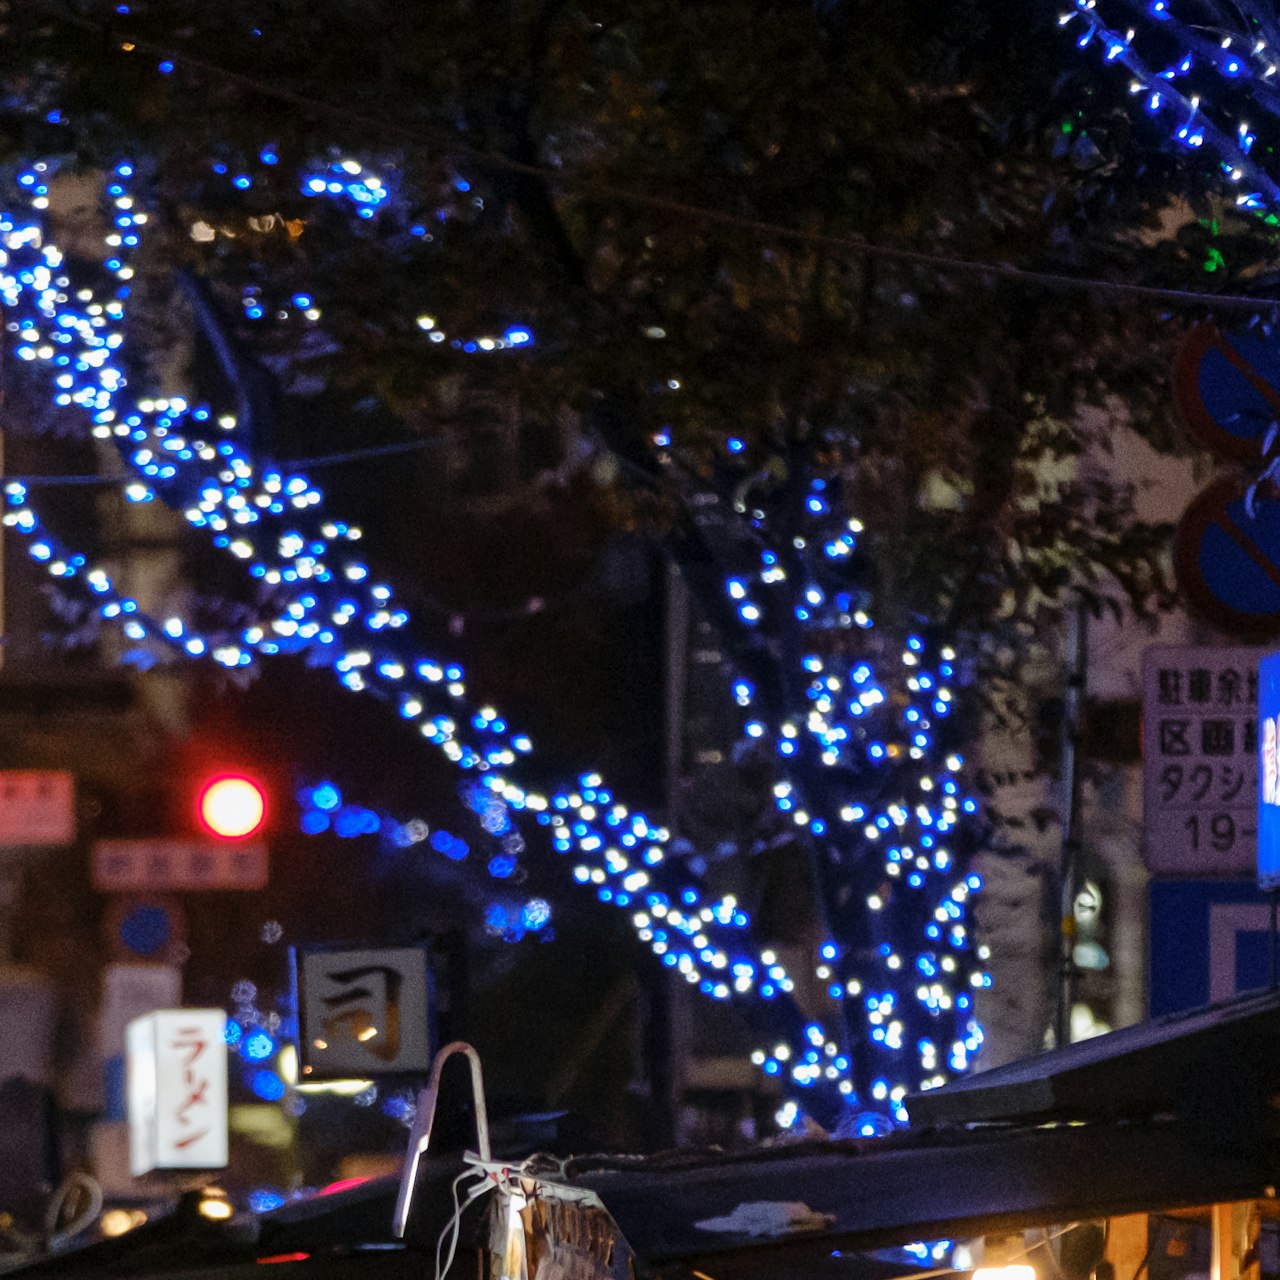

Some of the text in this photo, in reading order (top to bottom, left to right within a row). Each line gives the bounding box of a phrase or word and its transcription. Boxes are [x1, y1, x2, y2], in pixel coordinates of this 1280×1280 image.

[1161, 764, 1257, 802] タクシ
[171, 1027, 211, 1150] ラーメン
